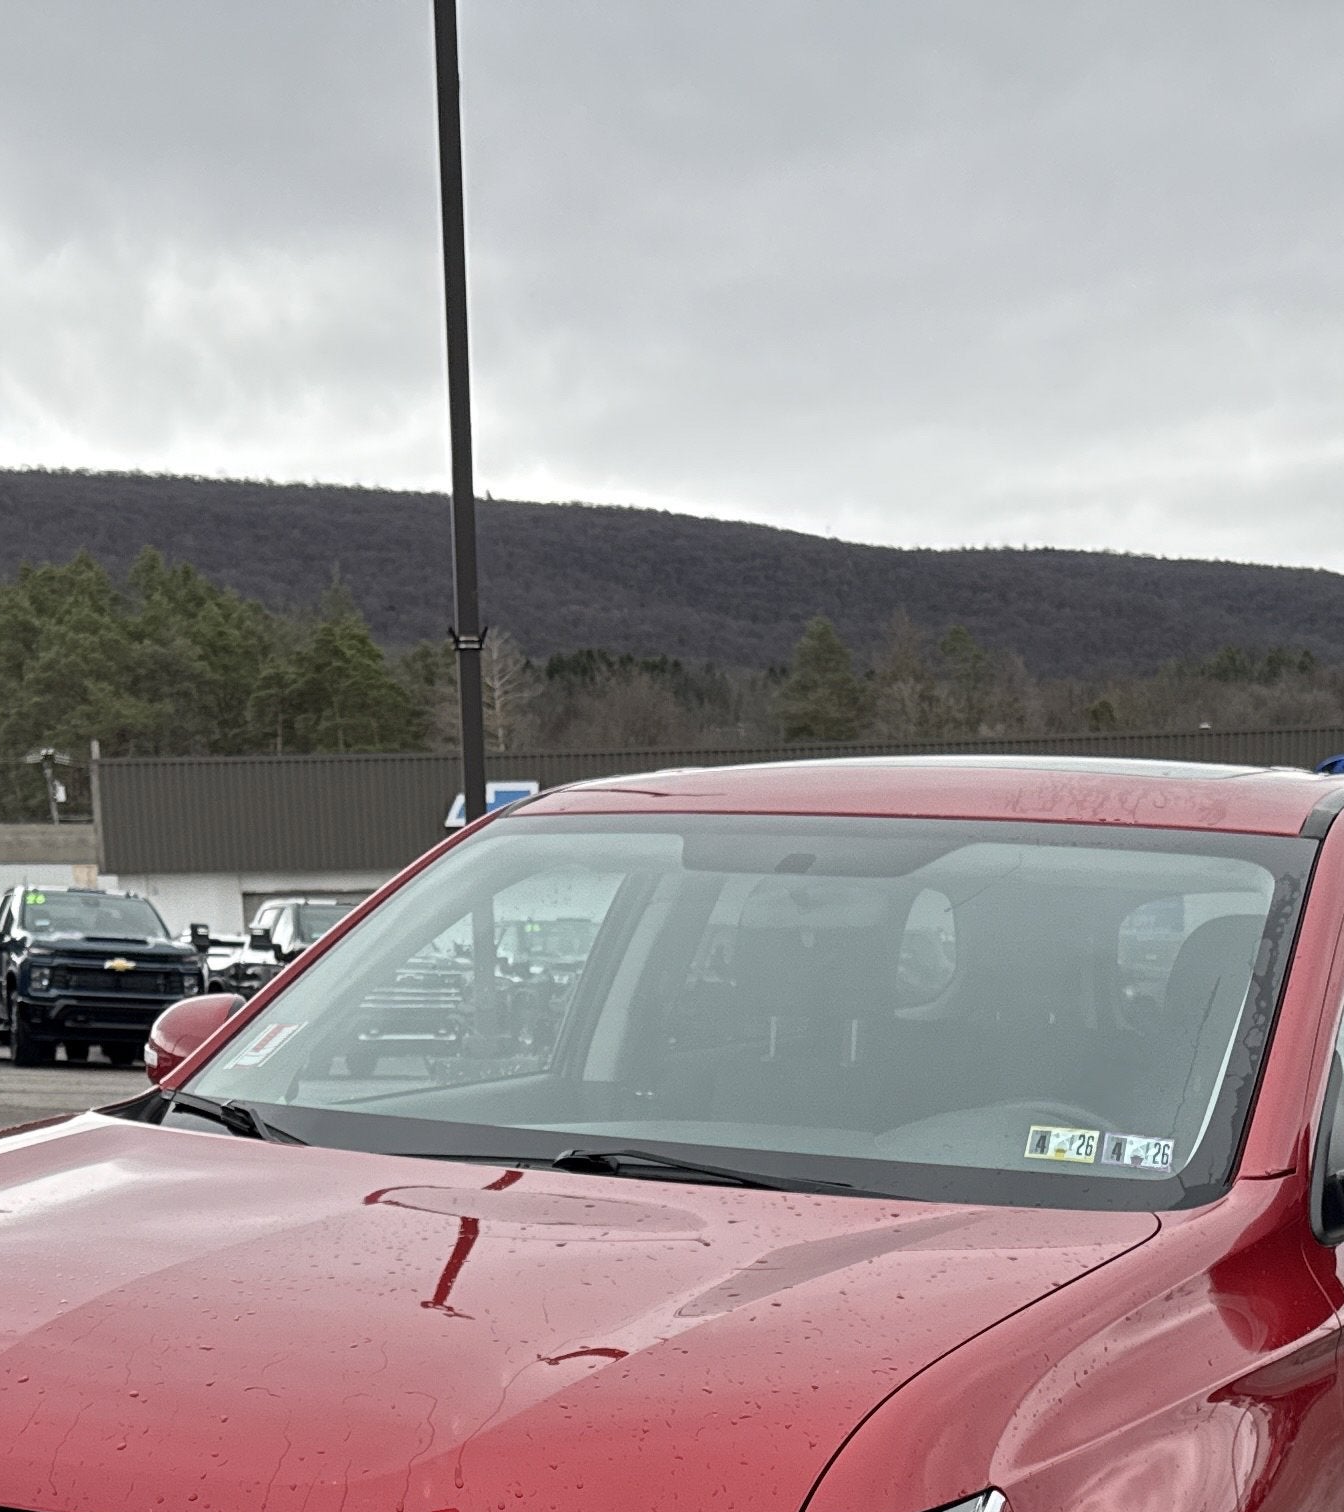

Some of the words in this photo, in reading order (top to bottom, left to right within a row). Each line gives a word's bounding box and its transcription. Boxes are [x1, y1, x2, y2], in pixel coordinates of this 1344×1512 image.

[1035, 1135, 1047, 1155] 4
[1076, 1134, 1095, 1156] 26
[1112, 1142, 1123, 1161] 4
[1153, 1142, 1170, 1165] 26
